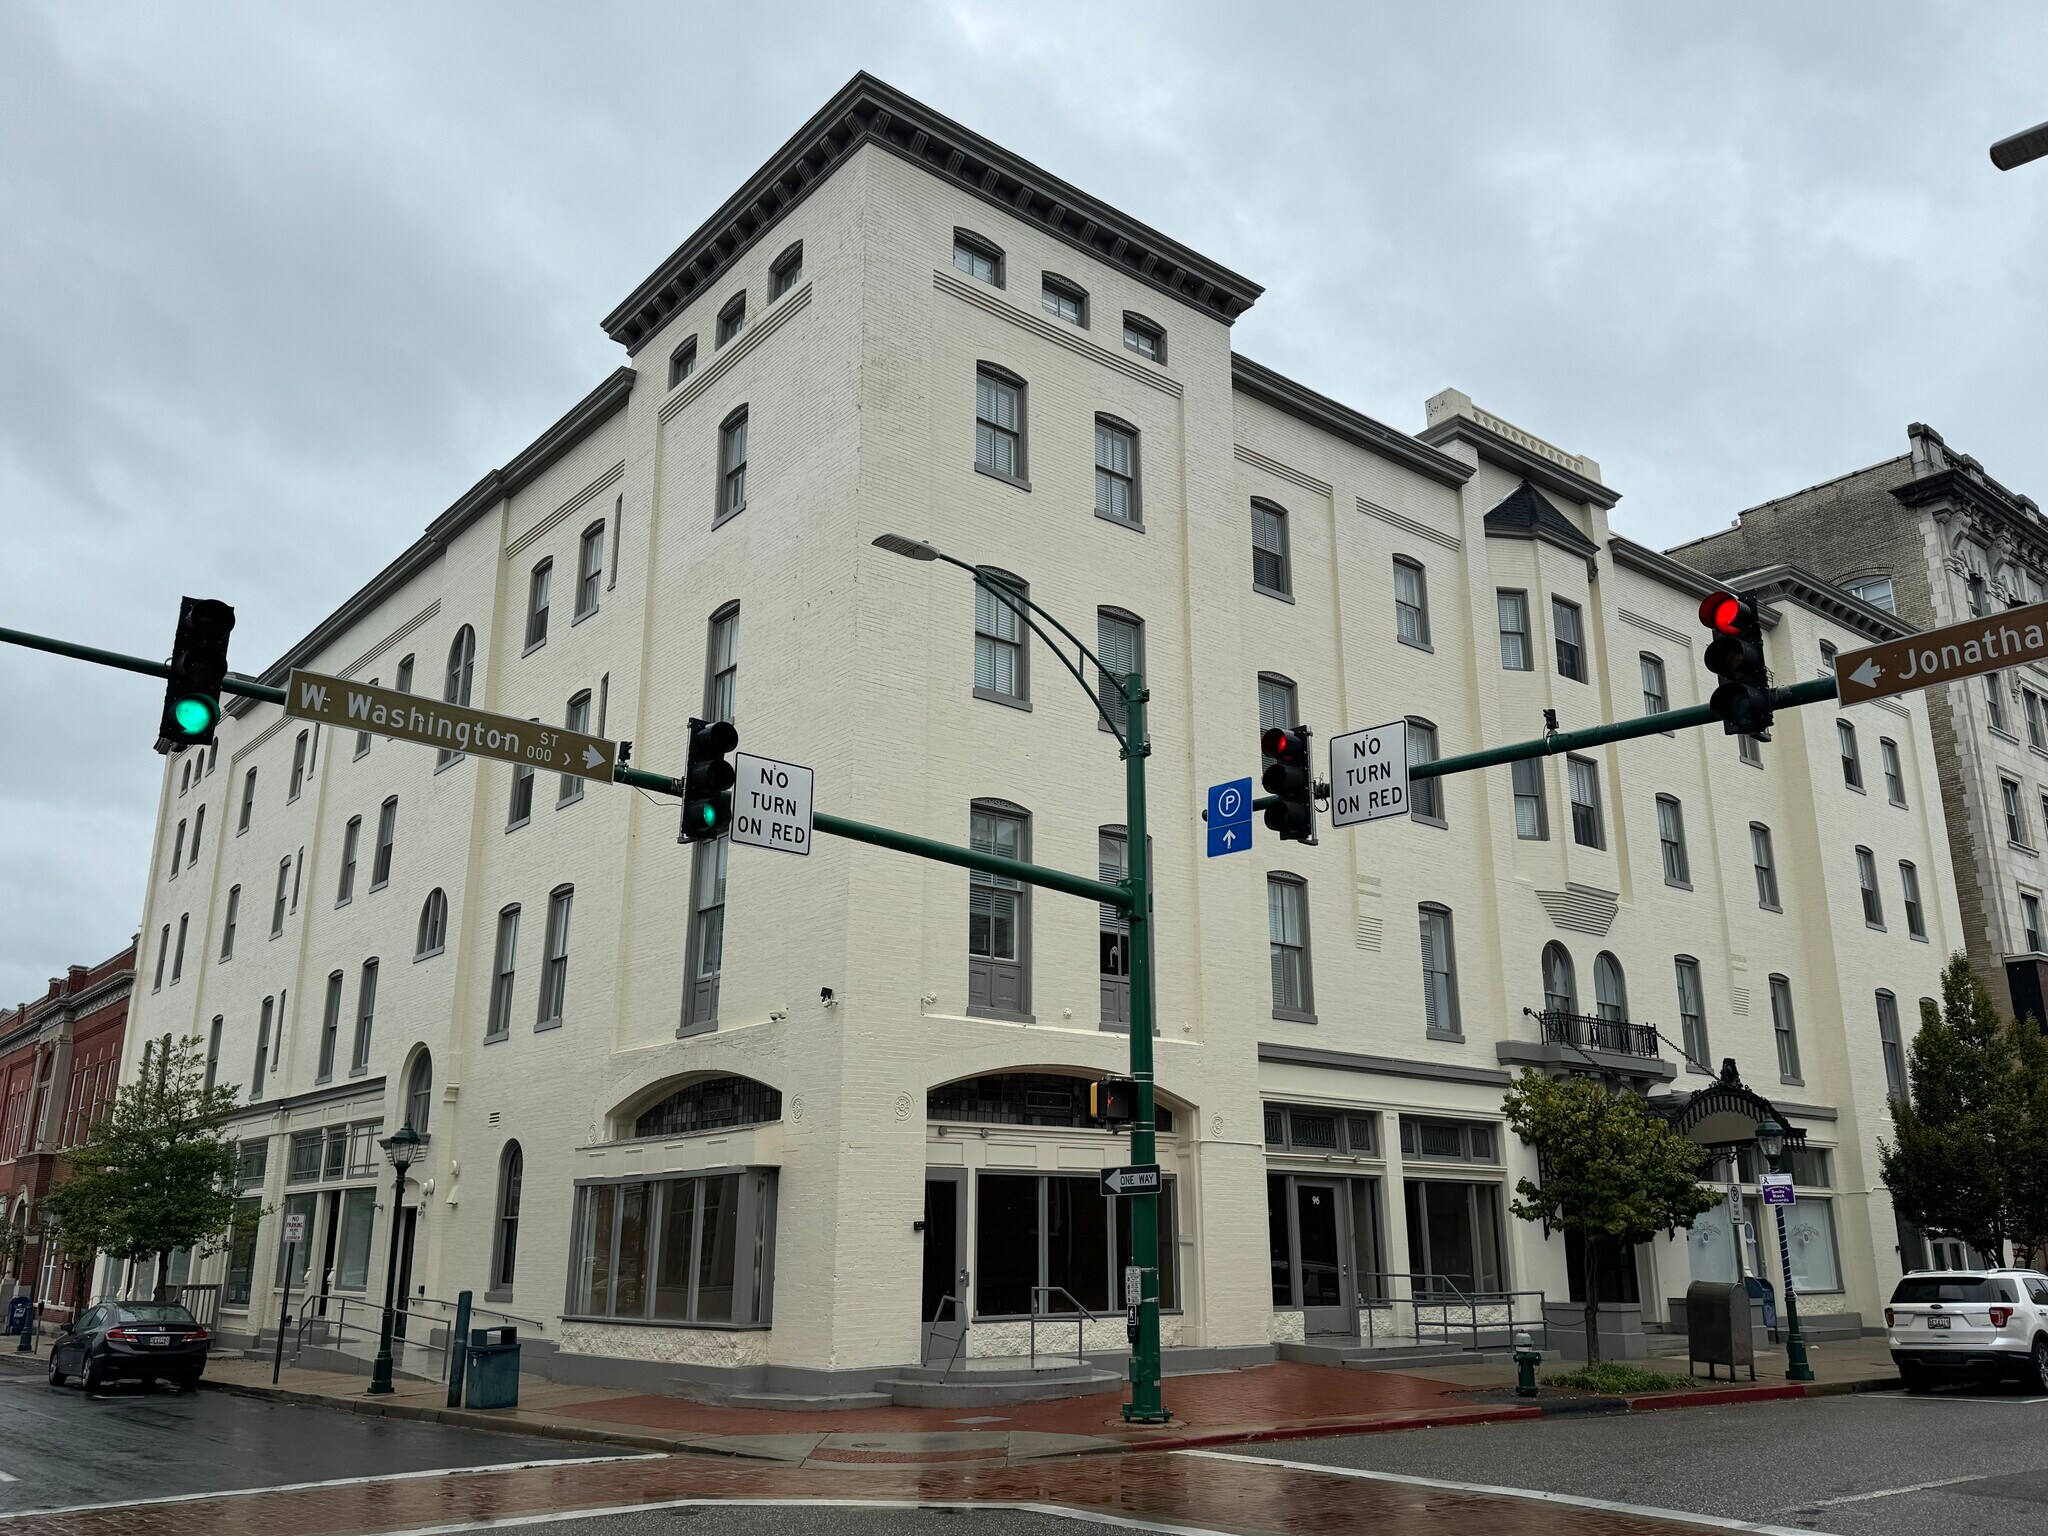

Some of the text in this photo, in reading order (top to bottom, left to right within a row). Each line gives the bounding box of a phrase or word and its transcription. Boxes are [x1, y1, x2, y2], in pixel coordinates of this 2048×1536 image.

[1898, 621, 2048, 680] Jonatha
[348, 691, 519, 753] Washington
[539, 731, 560, 747] ST
[1353, 737, 1381, 759] NO
[526, 744, 552, 763] 000
[760, 767, 789, 788] NO
[1345, 760, 1391, 787] TURN
[750, 791, 797, 817] TURN
[1337, 786, 1403, 815] ON RED
[737, 815, 805, 844] ON RED
[1120, 1173, 1154, 1186] ONE WAY
[1312, 1196, 1320, 1205] 96
